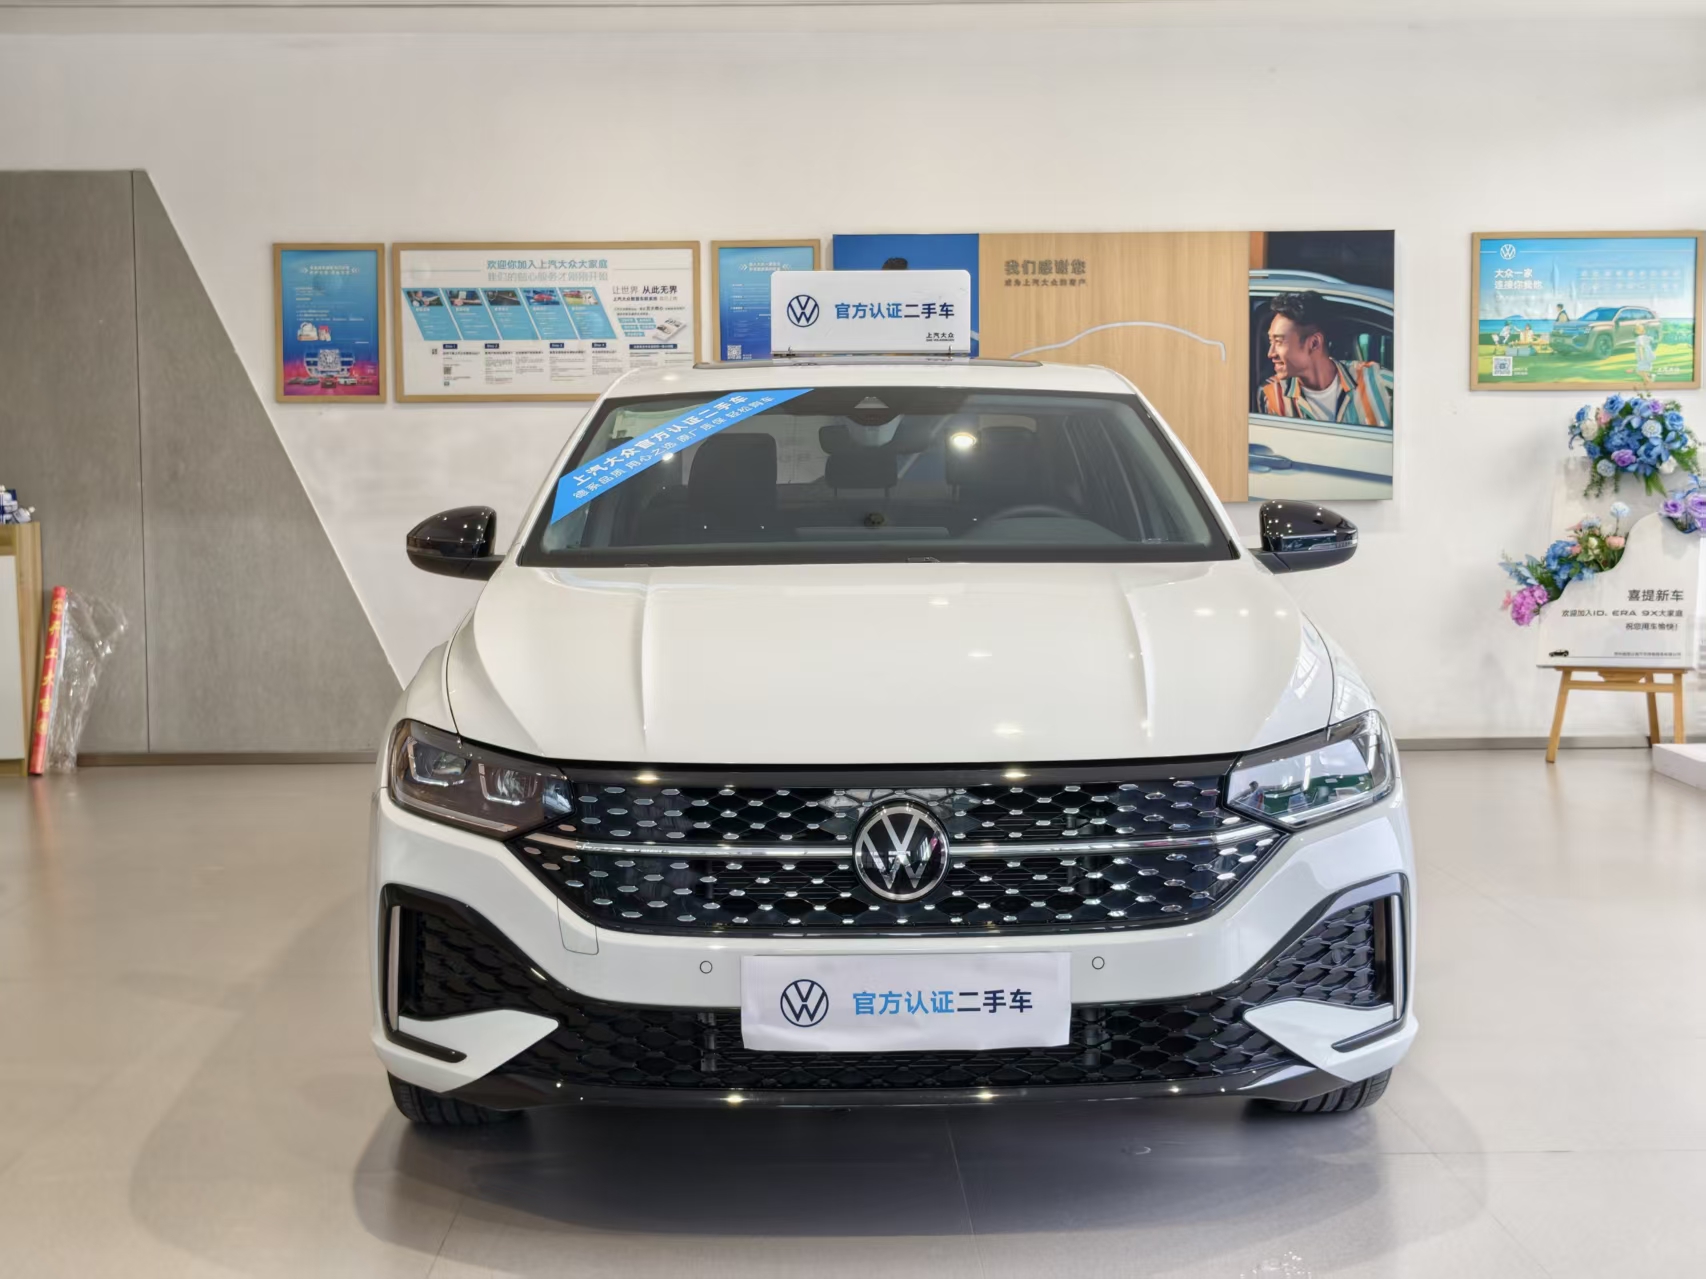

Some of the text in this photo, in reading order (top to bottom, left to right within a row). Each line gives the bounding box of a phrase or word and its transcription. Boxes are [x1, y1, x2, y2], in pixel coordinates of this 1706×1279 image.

[487, 259, 608, 270] 欢迎你加入上汽大众大家庭
[1004, 259, 1086, 275] 我们感谢您
[1494, 268, 1533, 279] 大众一家
[612, 285, 678, 295] 让世界 从此无界
[835, 302, 955, 320] 官方认证二手车
[573, 395, 748, 486] 上汽大众官方认证二手车
[572, 468, 626, 499] 德系品质
[1628, 589, 1685, 602] 喜提新车
[1561, 609, 1608, 617] 欢迎加入ID.
[1641, 609, 1684, 617] 9X大家庭
[852, 988, 1033, 1015] 官方认证二手车
